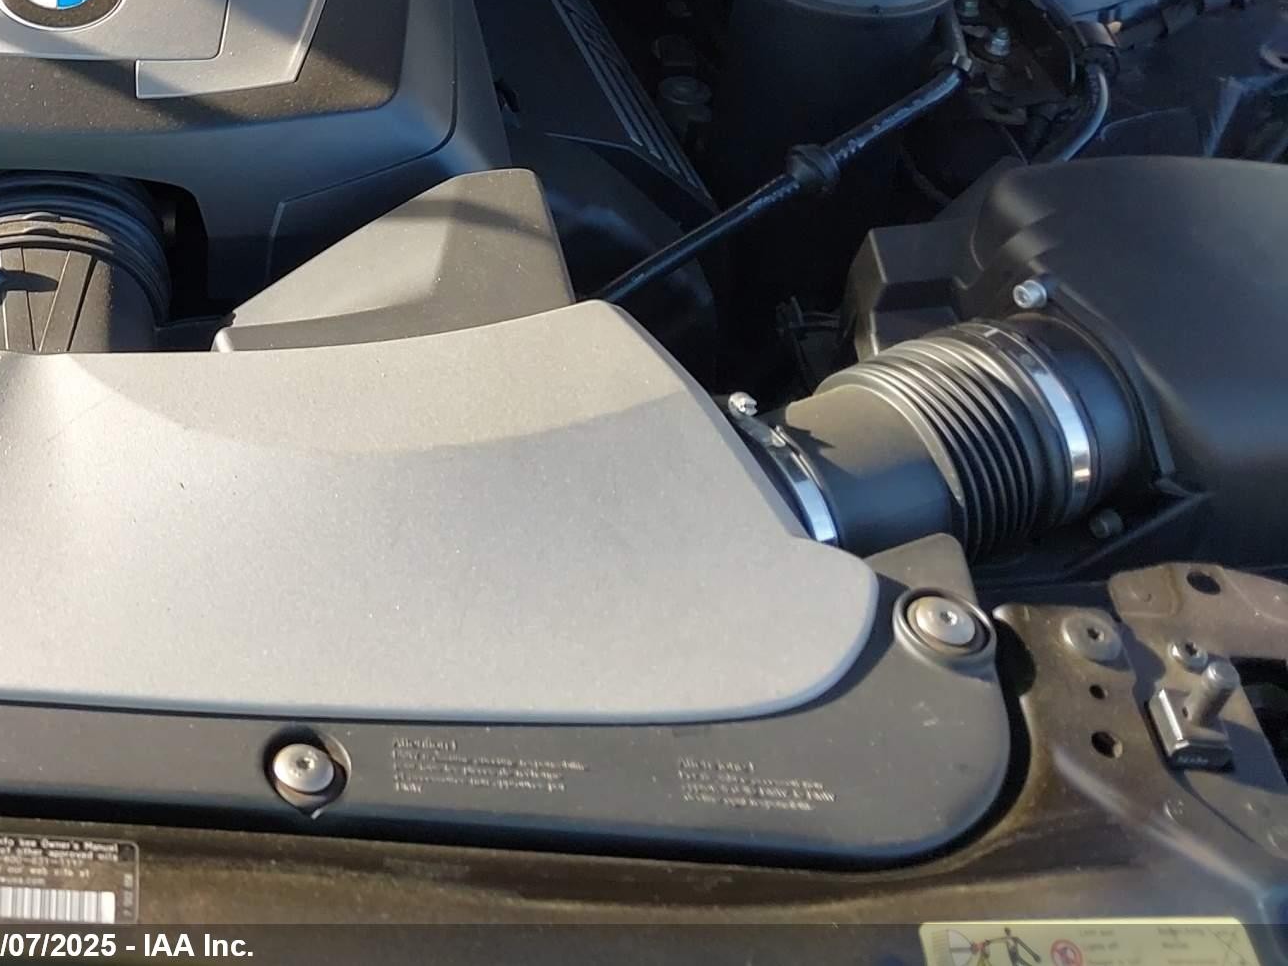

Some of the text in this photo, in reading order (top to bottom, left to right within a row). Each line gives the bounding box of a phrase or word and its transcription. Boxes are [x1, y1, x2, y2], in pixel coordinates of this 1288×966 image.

[40, 838, 81, 851] Owner's
[83, 841, 119, 853] Manual
[47, 849, 94, 861] approved
